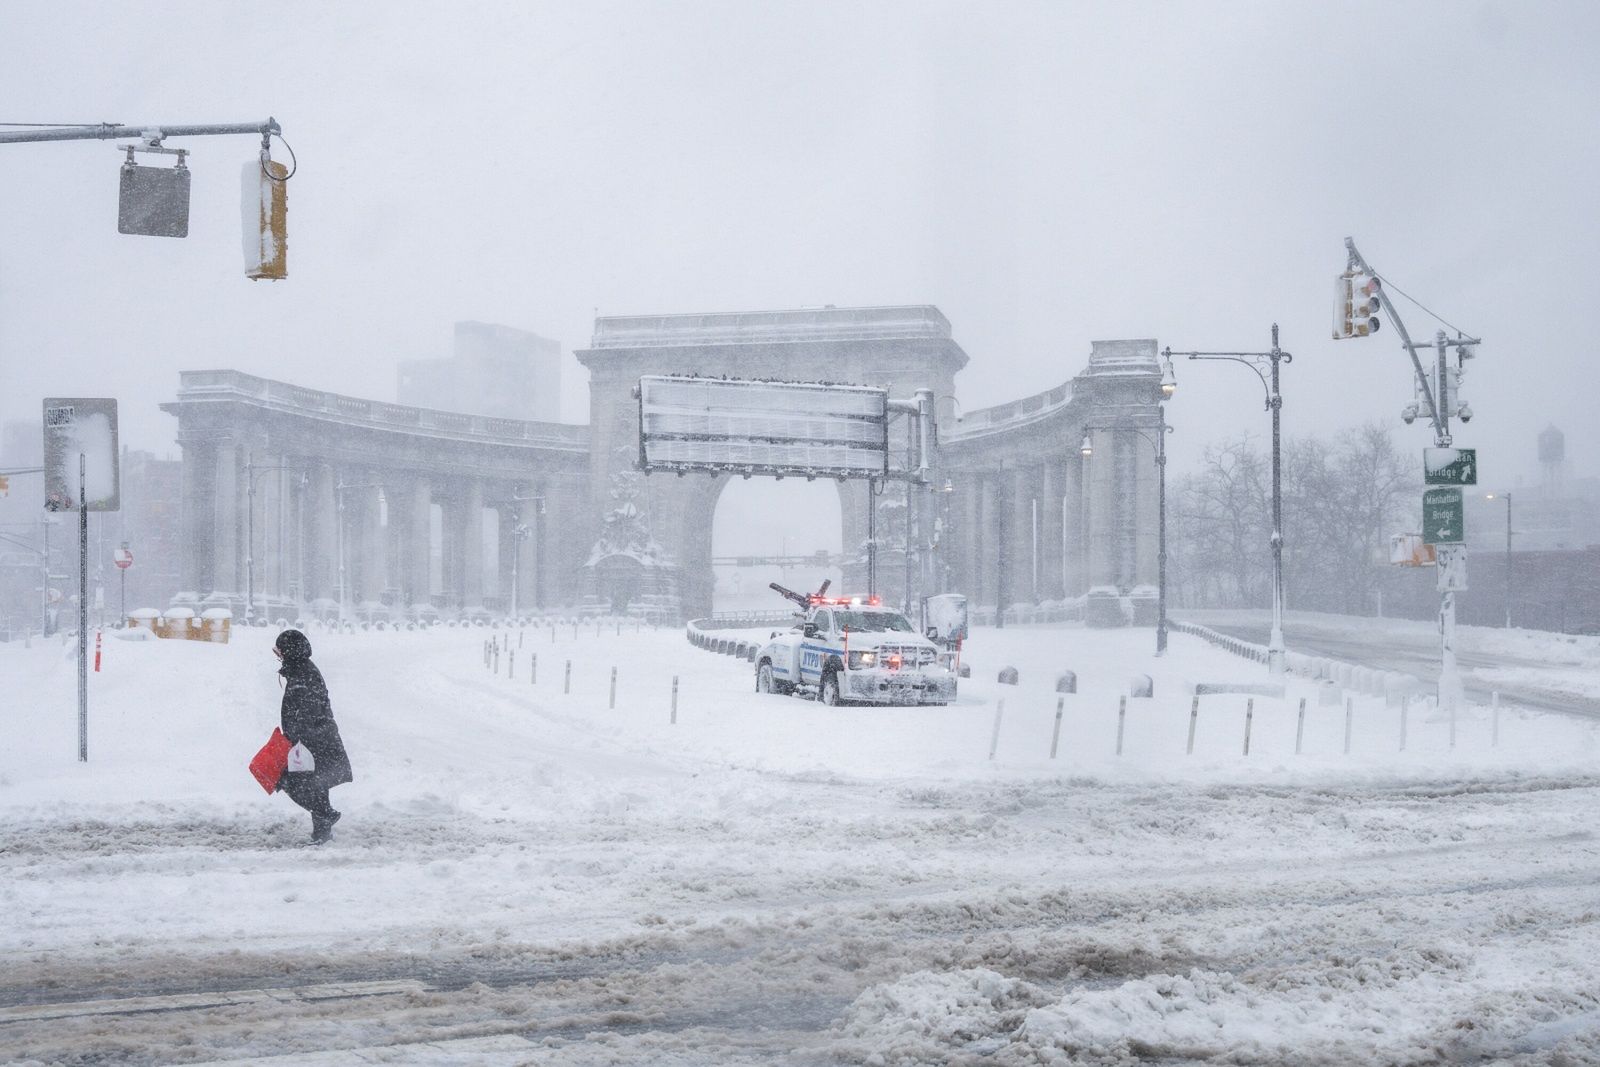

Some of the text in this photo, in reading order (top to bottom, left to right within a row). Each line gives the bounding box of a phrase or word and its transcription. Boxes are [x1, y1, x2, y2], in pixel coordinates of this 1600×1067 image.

[1426, 495, 1459, 505] Manhattan
[1432, 510, 1454, 520] Bridge
[803, 648, 819, 668] NYPD
